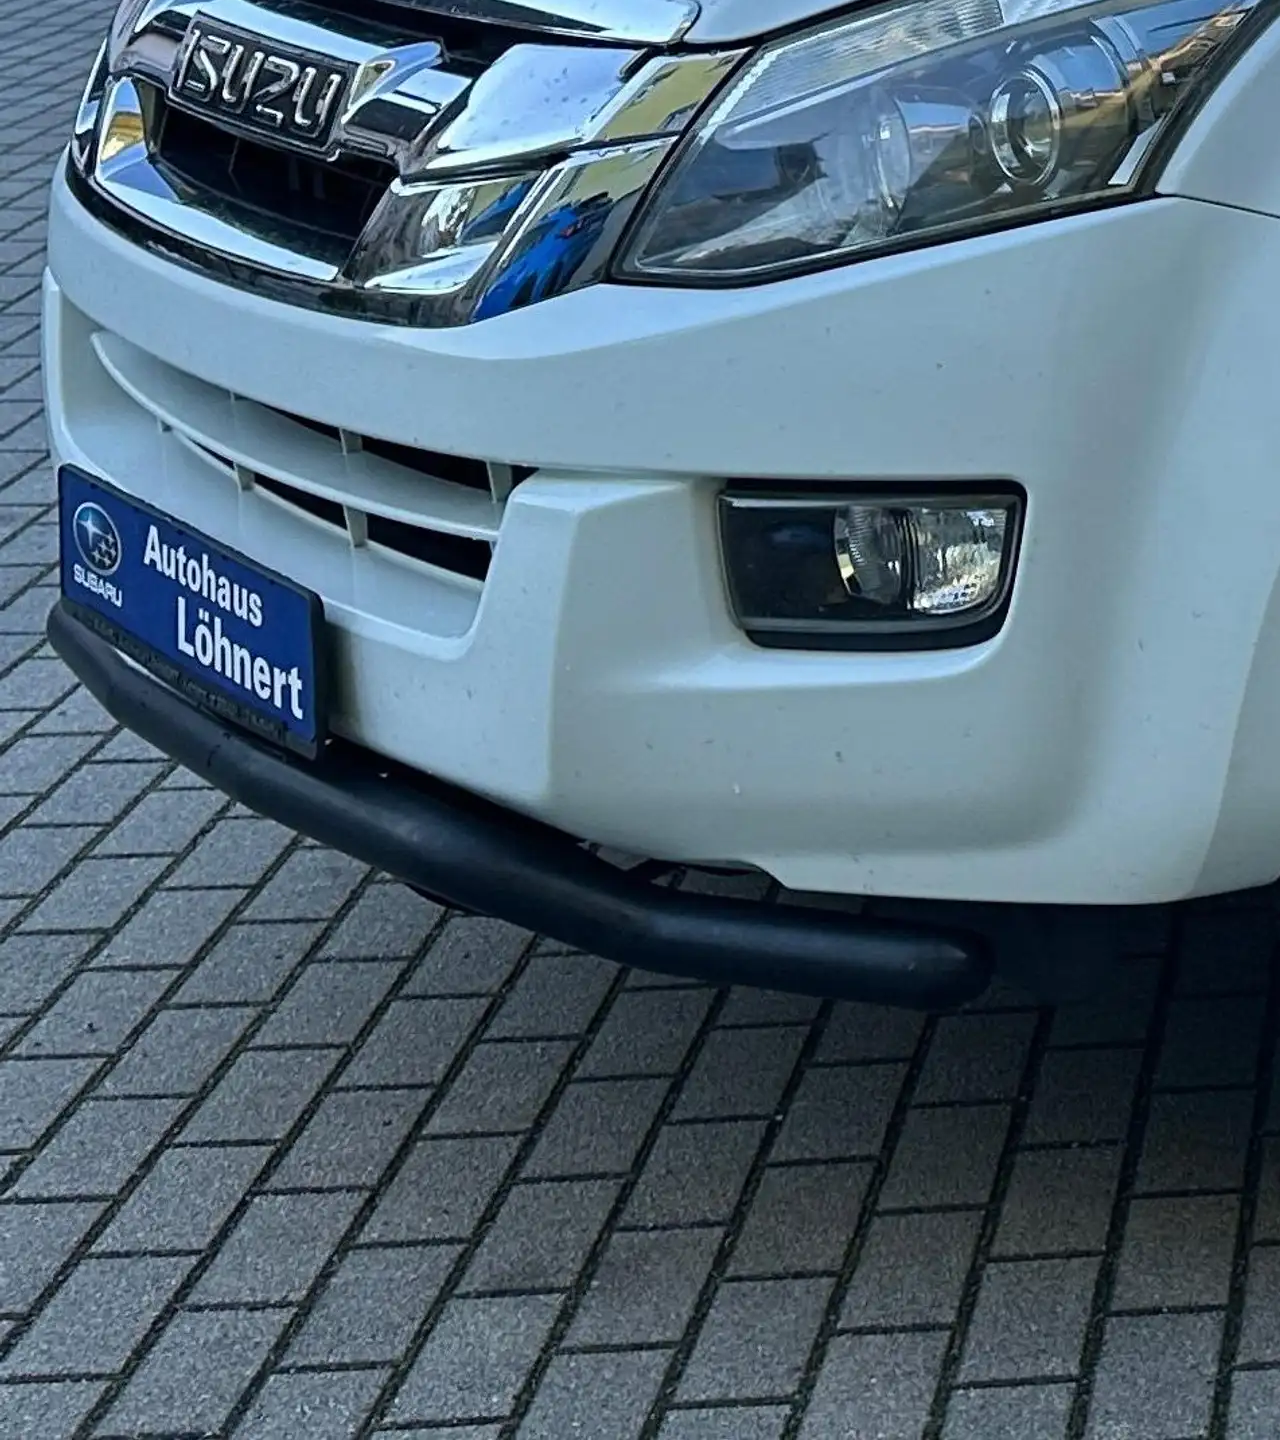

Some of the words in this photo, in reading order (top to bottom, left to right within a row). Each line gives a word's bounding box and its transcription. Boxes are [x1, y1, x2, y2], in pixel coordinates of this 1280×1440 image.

[176, 29, 342, 139] ISUZU
[73, 563, 123, 608] SUBARU
[144, 525, 263, 627] Autohaus
[177, 596, 304, 720] Löhnert
